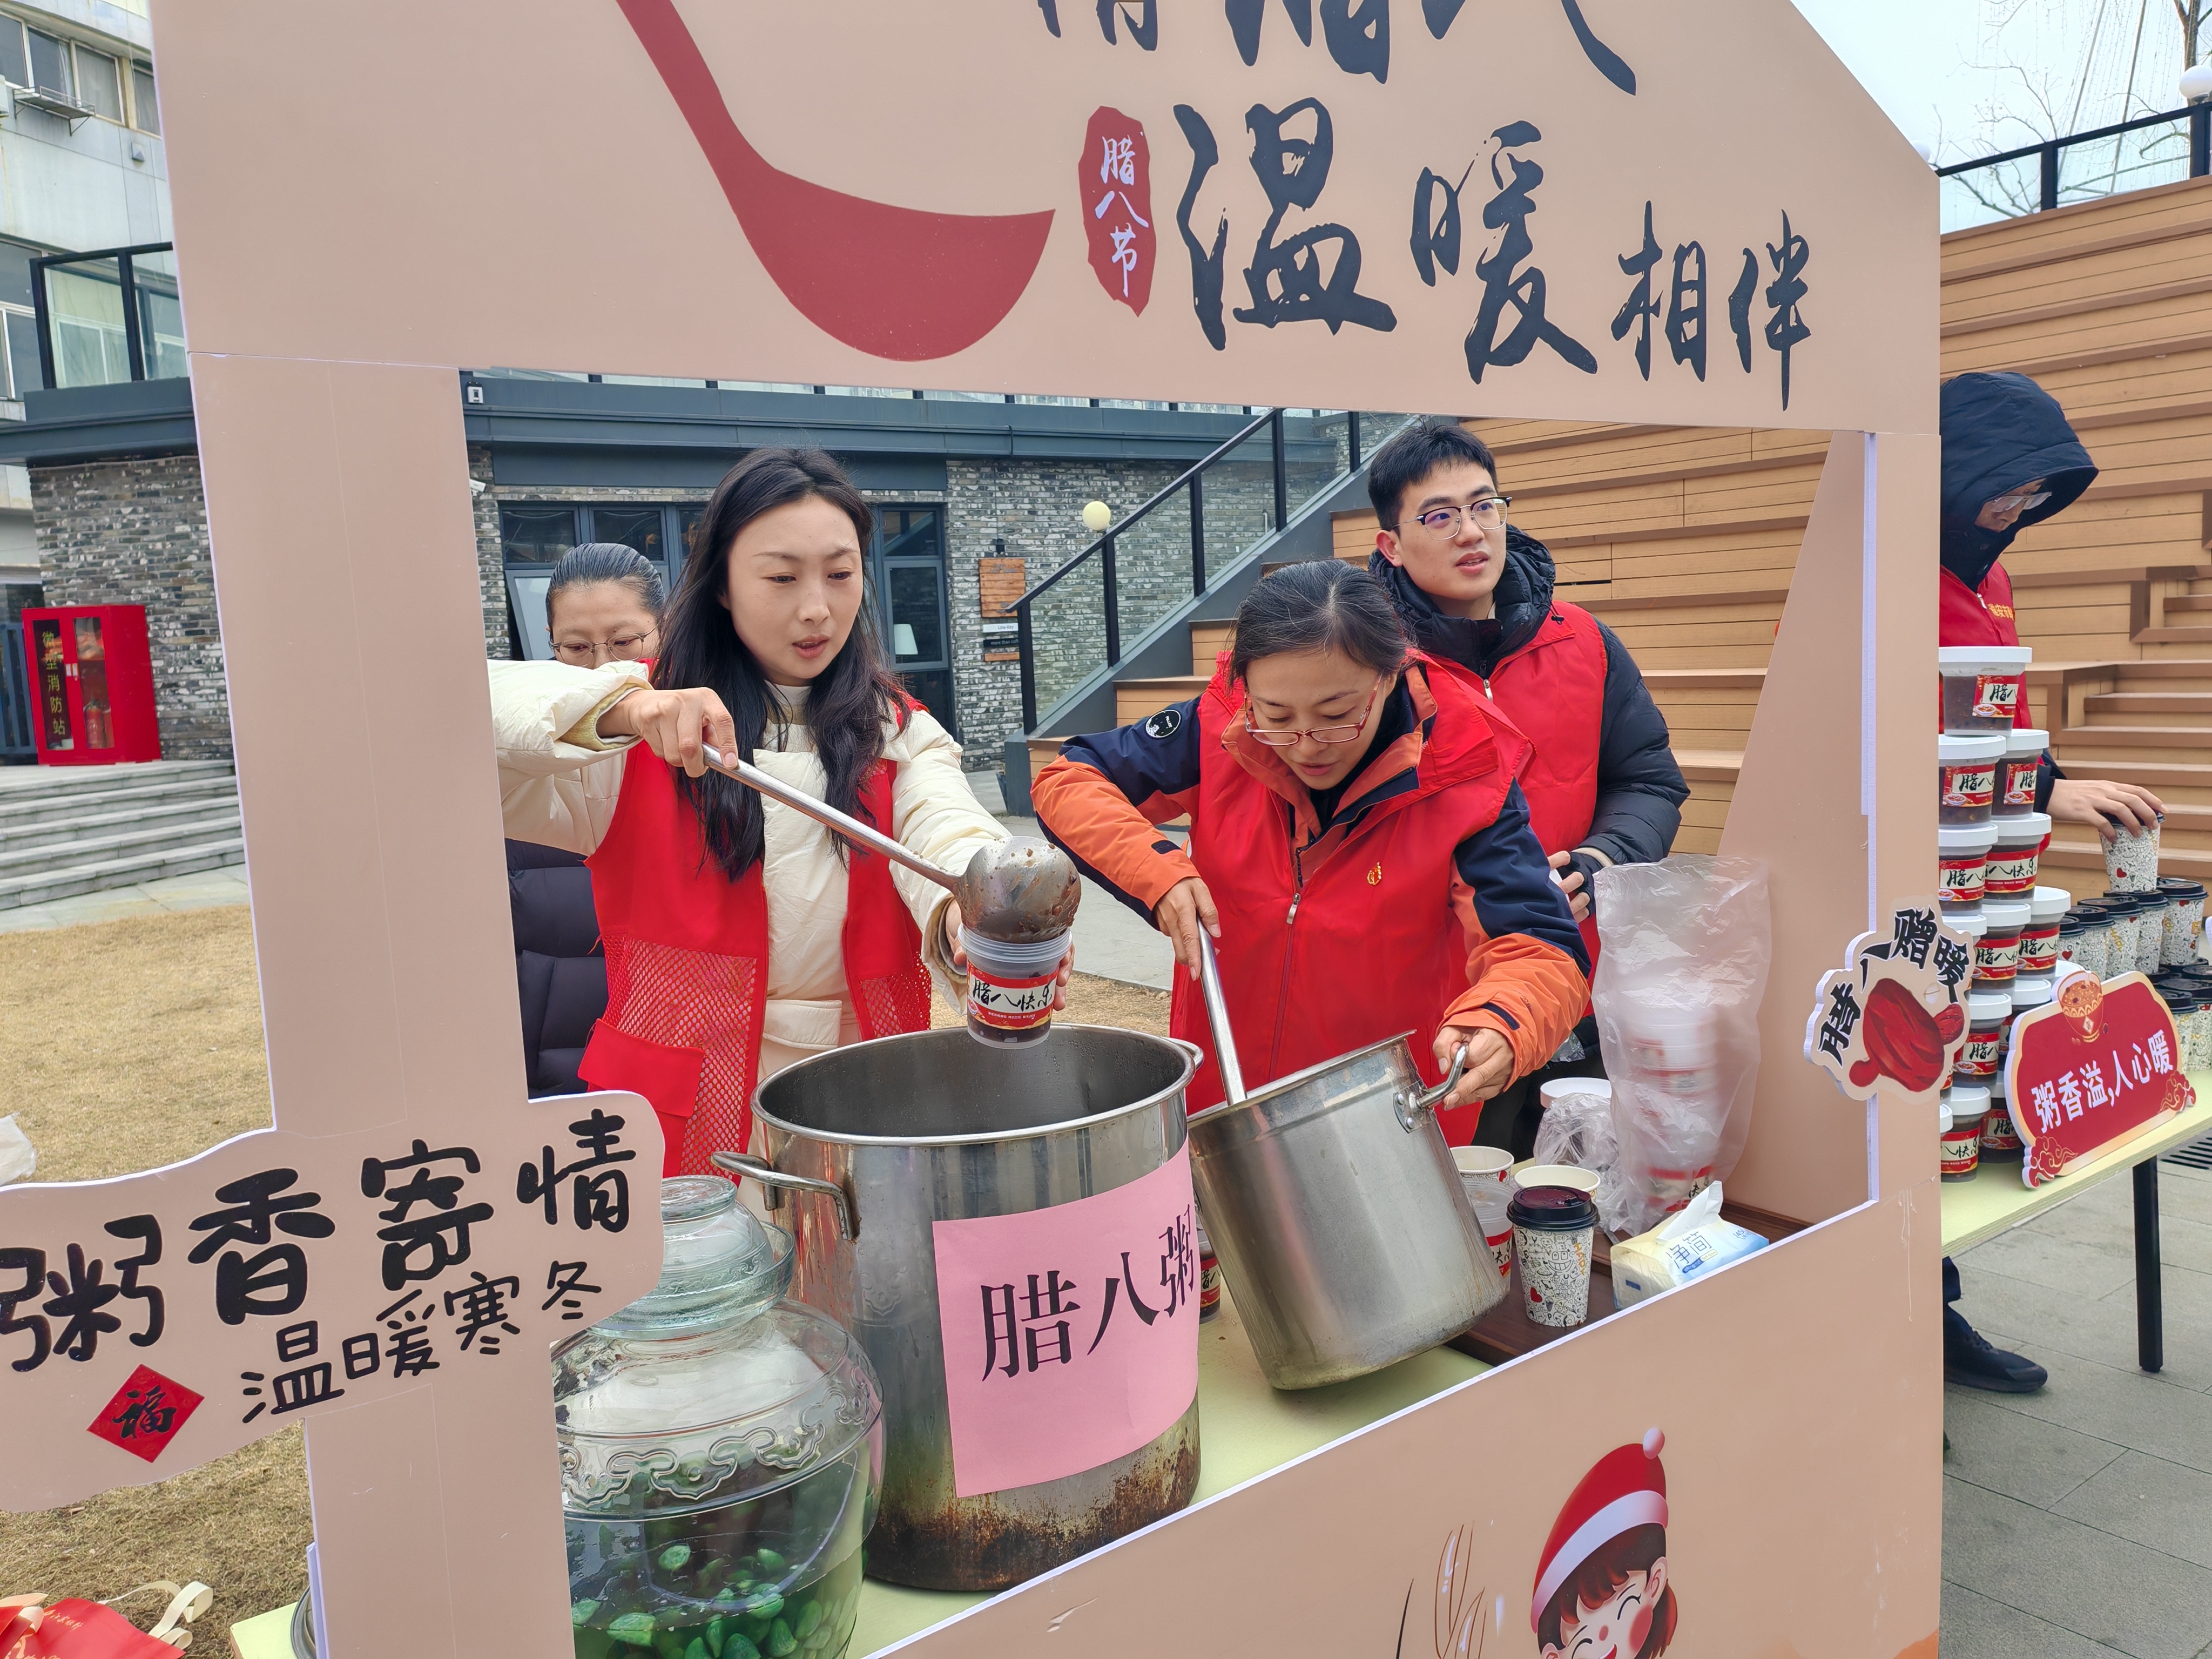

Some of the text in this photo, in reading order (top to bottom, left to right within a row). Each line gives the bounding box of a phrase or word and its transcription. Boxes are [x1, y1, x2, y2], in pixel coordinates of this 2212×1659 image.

[1095, 136, 1148, 297] 腊八节
[973, 977, 1053, 1011] 腊八快乐
[0, 1109, 637, 1373] 粥香寄情
[981, 1203, 1195, 1382] 腊八粥
[1665, 1231, 1712, 1269] 净简
[112, 1385, 177, 1440] 福
[241, 1260, 603, 1424] 温暖寒冬
